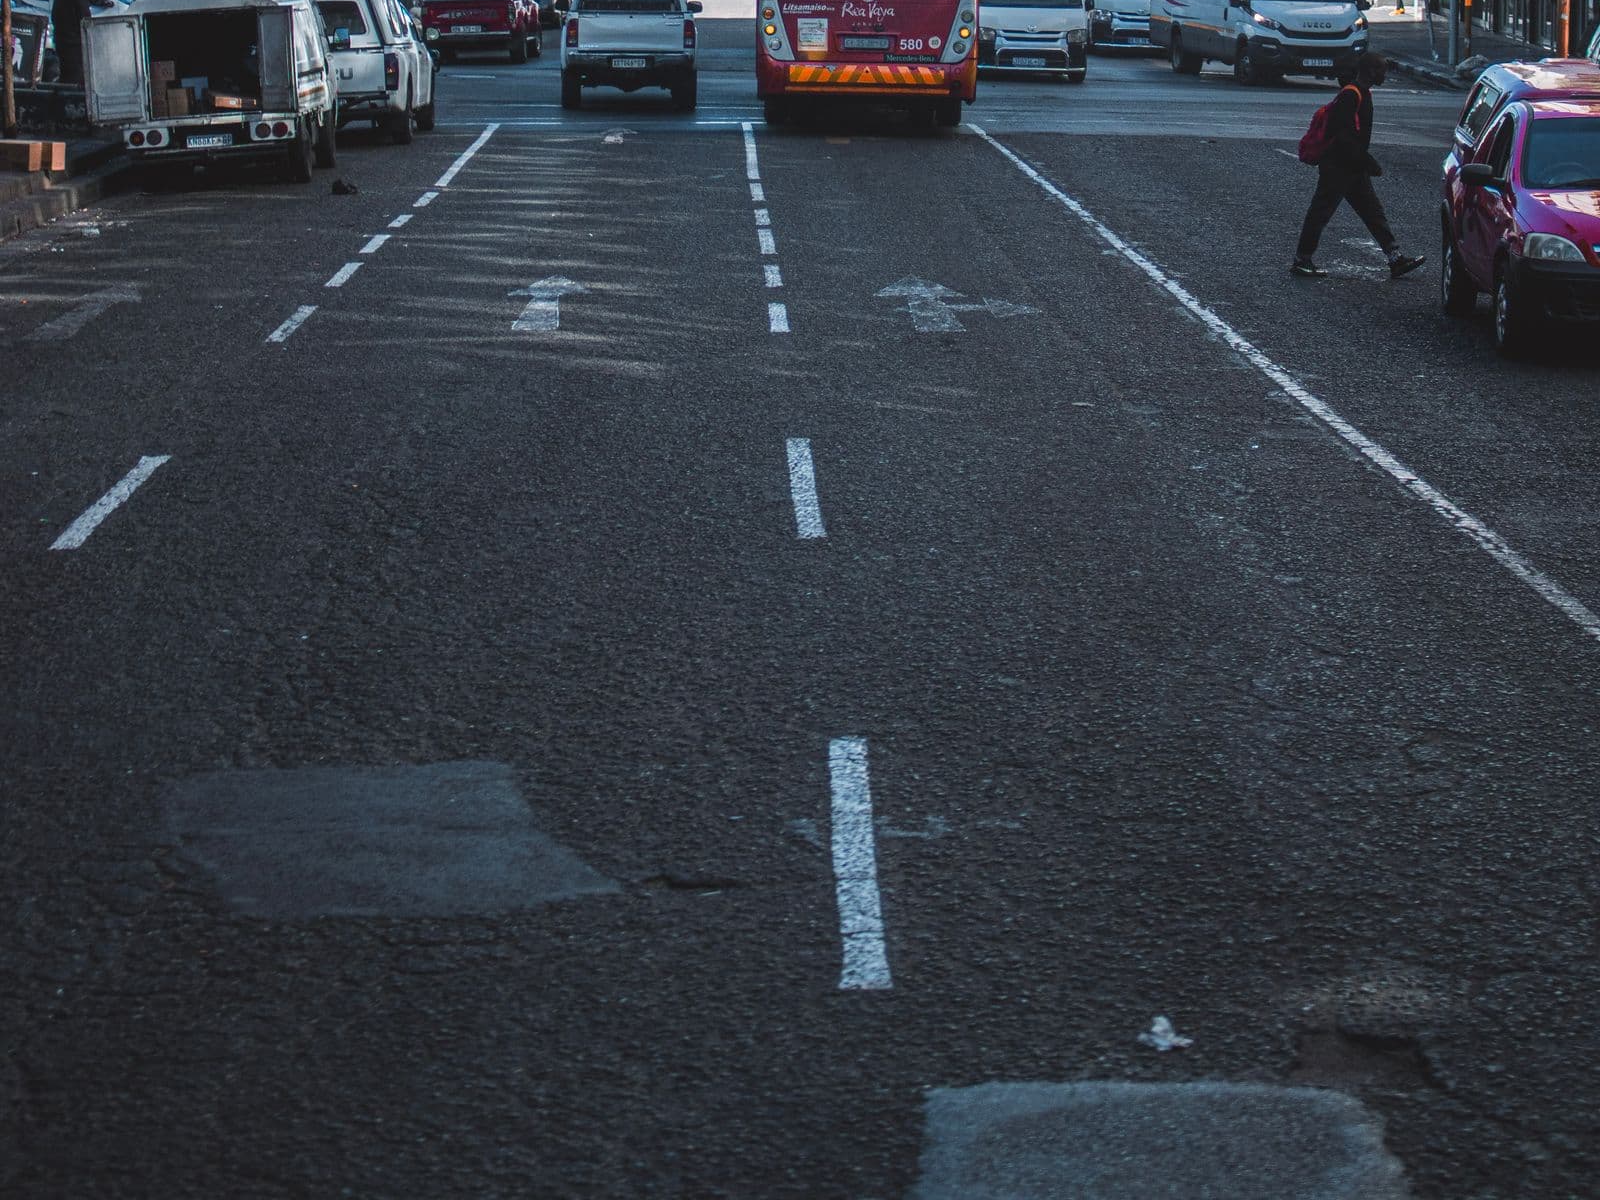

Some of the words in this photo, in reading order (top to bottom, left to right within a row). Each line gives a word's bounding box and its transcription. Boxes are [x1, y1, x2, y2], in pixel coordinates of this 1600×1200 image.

[783, 3, 827, 11] Litsamaiso
[841, 1, 866, 17] Rea
[867, 1, 896, 22] Vaya
[1302, 21, 1332, 29] IVECO
[900, 39, 923, 50] 580
